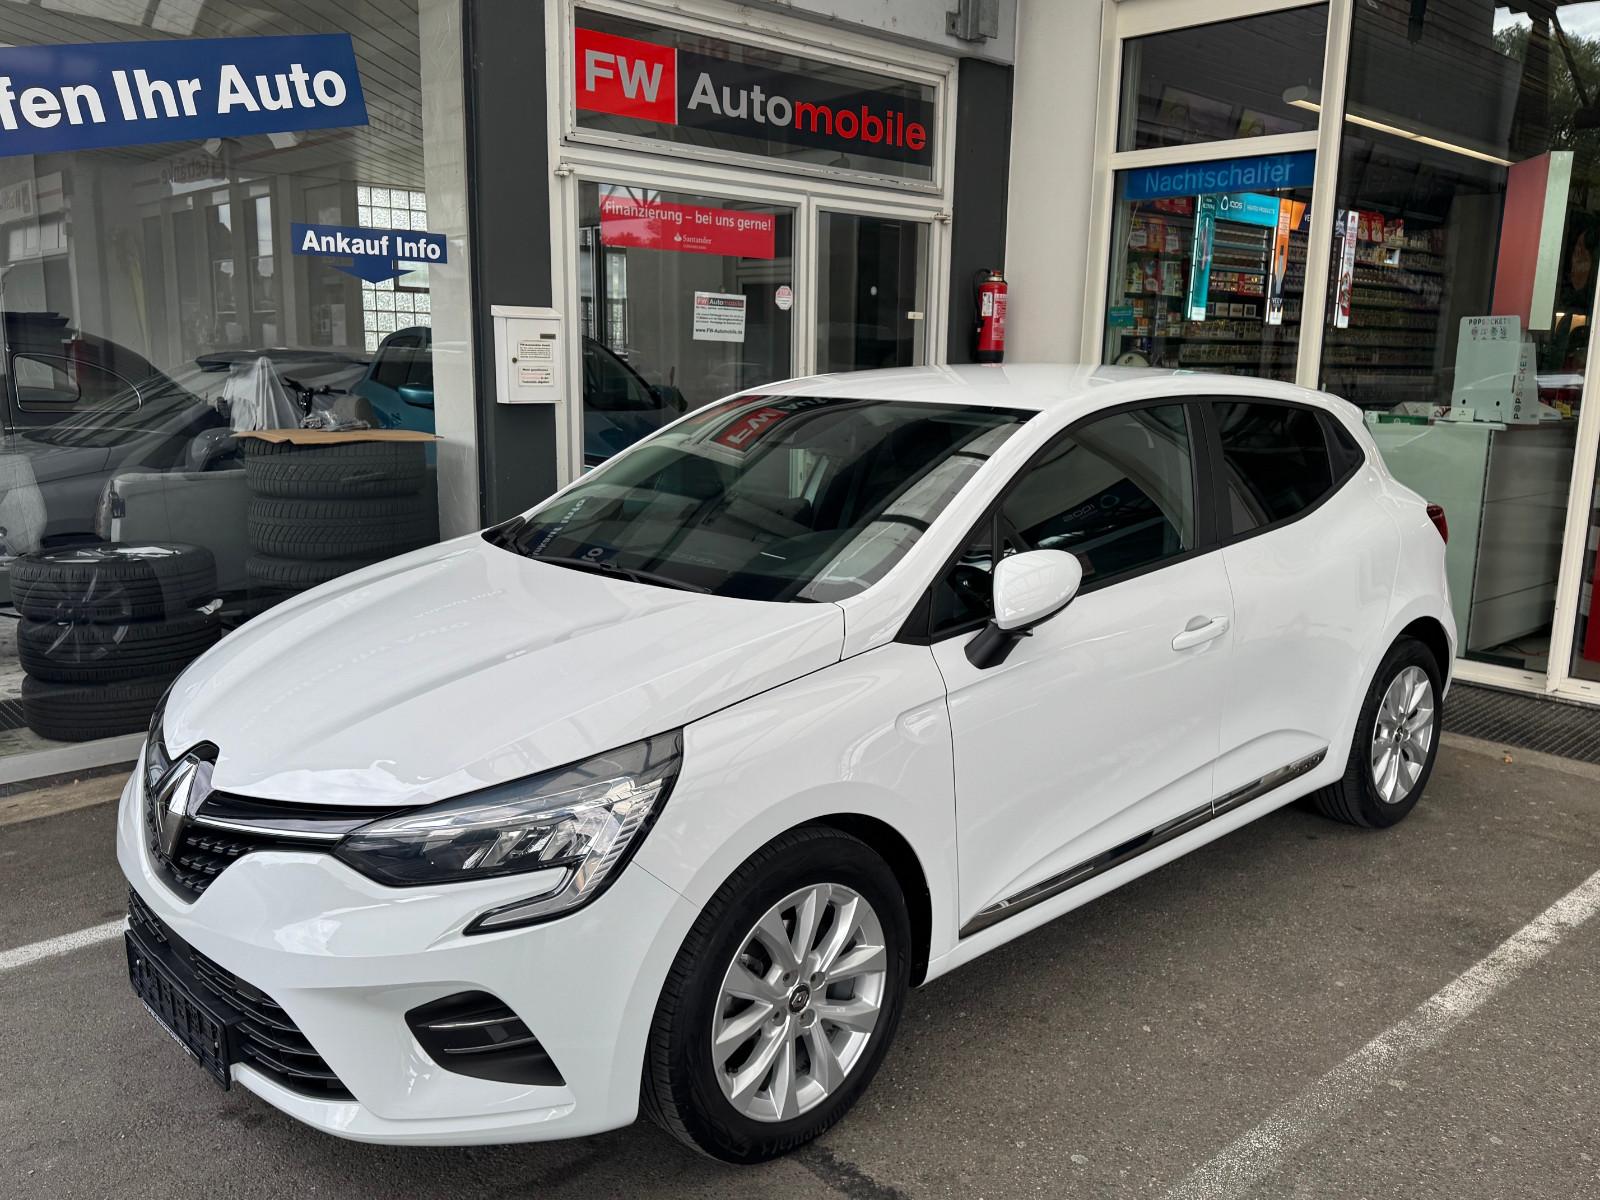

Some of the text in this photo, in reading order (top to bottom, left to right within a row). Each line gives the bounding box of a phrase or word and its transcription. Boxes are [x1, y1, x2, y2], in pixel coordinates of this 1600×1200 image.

[0, 63, 347, 131] fen Ihr Auto
[585, 48, 928, 151] FW Automobile
[1145, 161, 1295, 193] Nachtschalter
[605, 200, 683, 224] Finanzierung
[695, 210, 712, 225] bei
[716, 216, 735, 228] uns
[737, 218, 772, 232] gerne!
[302, 229, 441, 260] Ankauf Info
[682, 233, 712, 245] Santander
